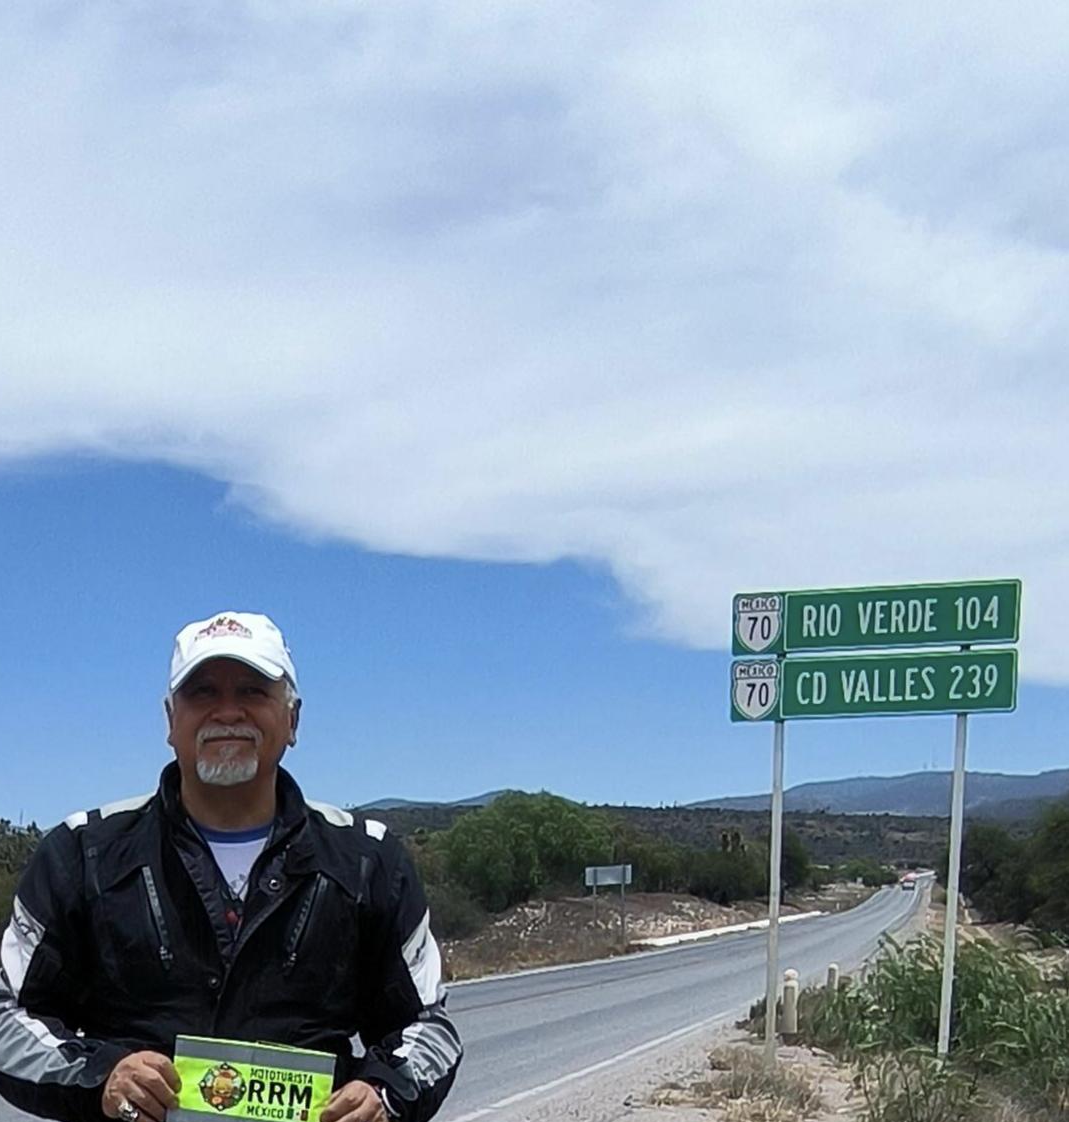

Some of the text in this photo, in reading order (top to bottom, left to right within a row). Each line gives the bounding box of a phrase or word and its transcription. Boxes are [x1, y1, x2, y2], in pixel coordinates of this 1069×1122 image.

[747, 615, 771, 641] 70
[802, 595, 999, 638] RIO VERDE 104
[746, 682, 769, 707] 70
[796, 664, 998, 705] CD VALLES 239
[250, 1067, 313, 1085] MOTOTURISTA
[248, 1079, 313, 1110] RRM
